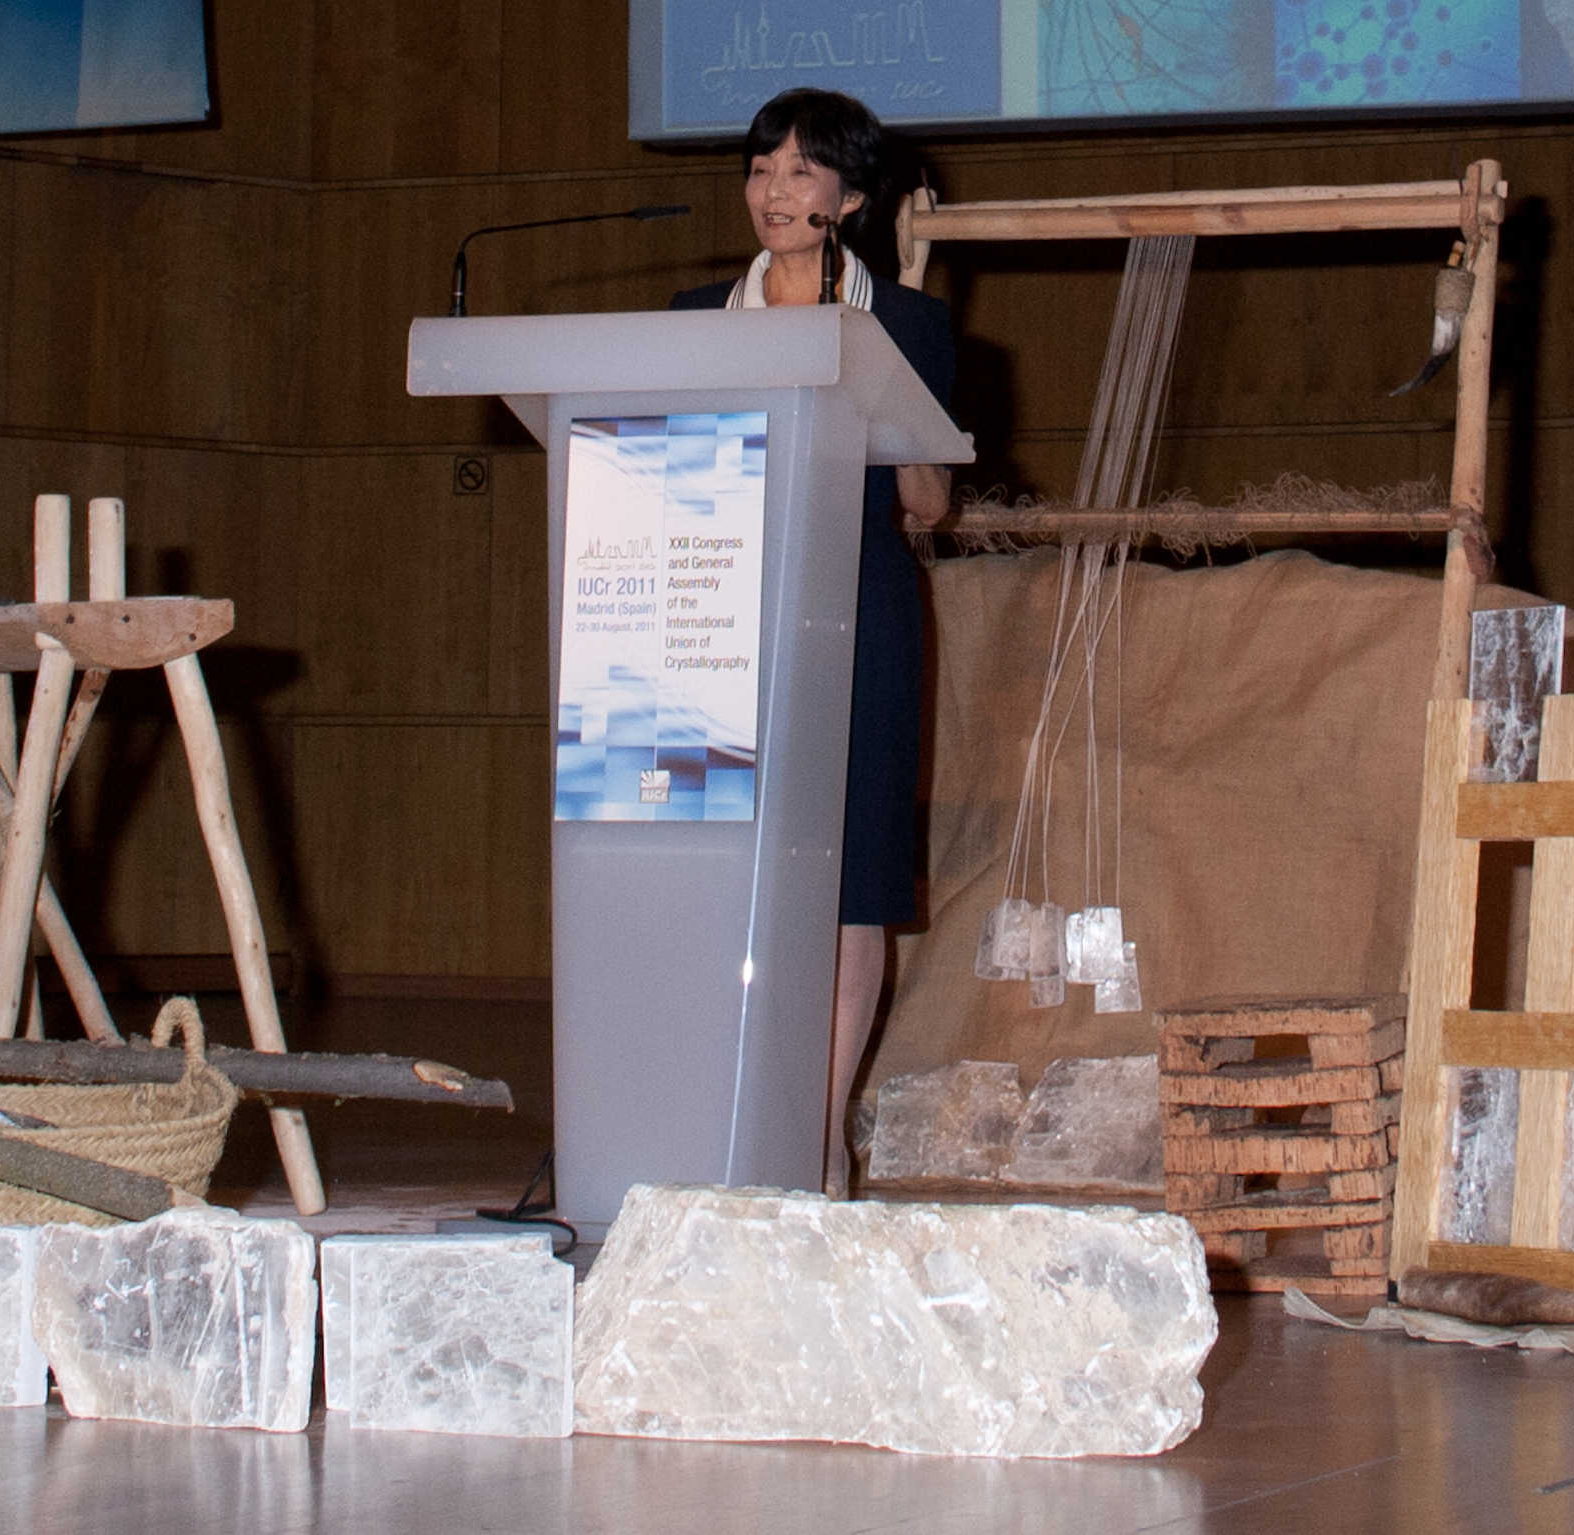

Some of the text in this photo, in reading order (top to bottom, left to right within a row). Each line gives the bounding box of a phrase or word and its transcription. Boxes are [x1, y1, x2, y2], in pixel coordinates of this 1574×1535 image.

[669, 536, 744, 551] XXII Congress
[668, 557, 689, 569] and
[692, 556, 734, 569] General
[578, 577, 655, 596] IUCr 2011
[667, 576, 720, 591] Assembly
[577, 602, 656, 616] Madrid (Spain)
[667, 596, 698, 609] of the
[666, 616, 735, 629] International
[665, 635, 710, 649] Union of
[665, 655, 750, 672] Crystallography
